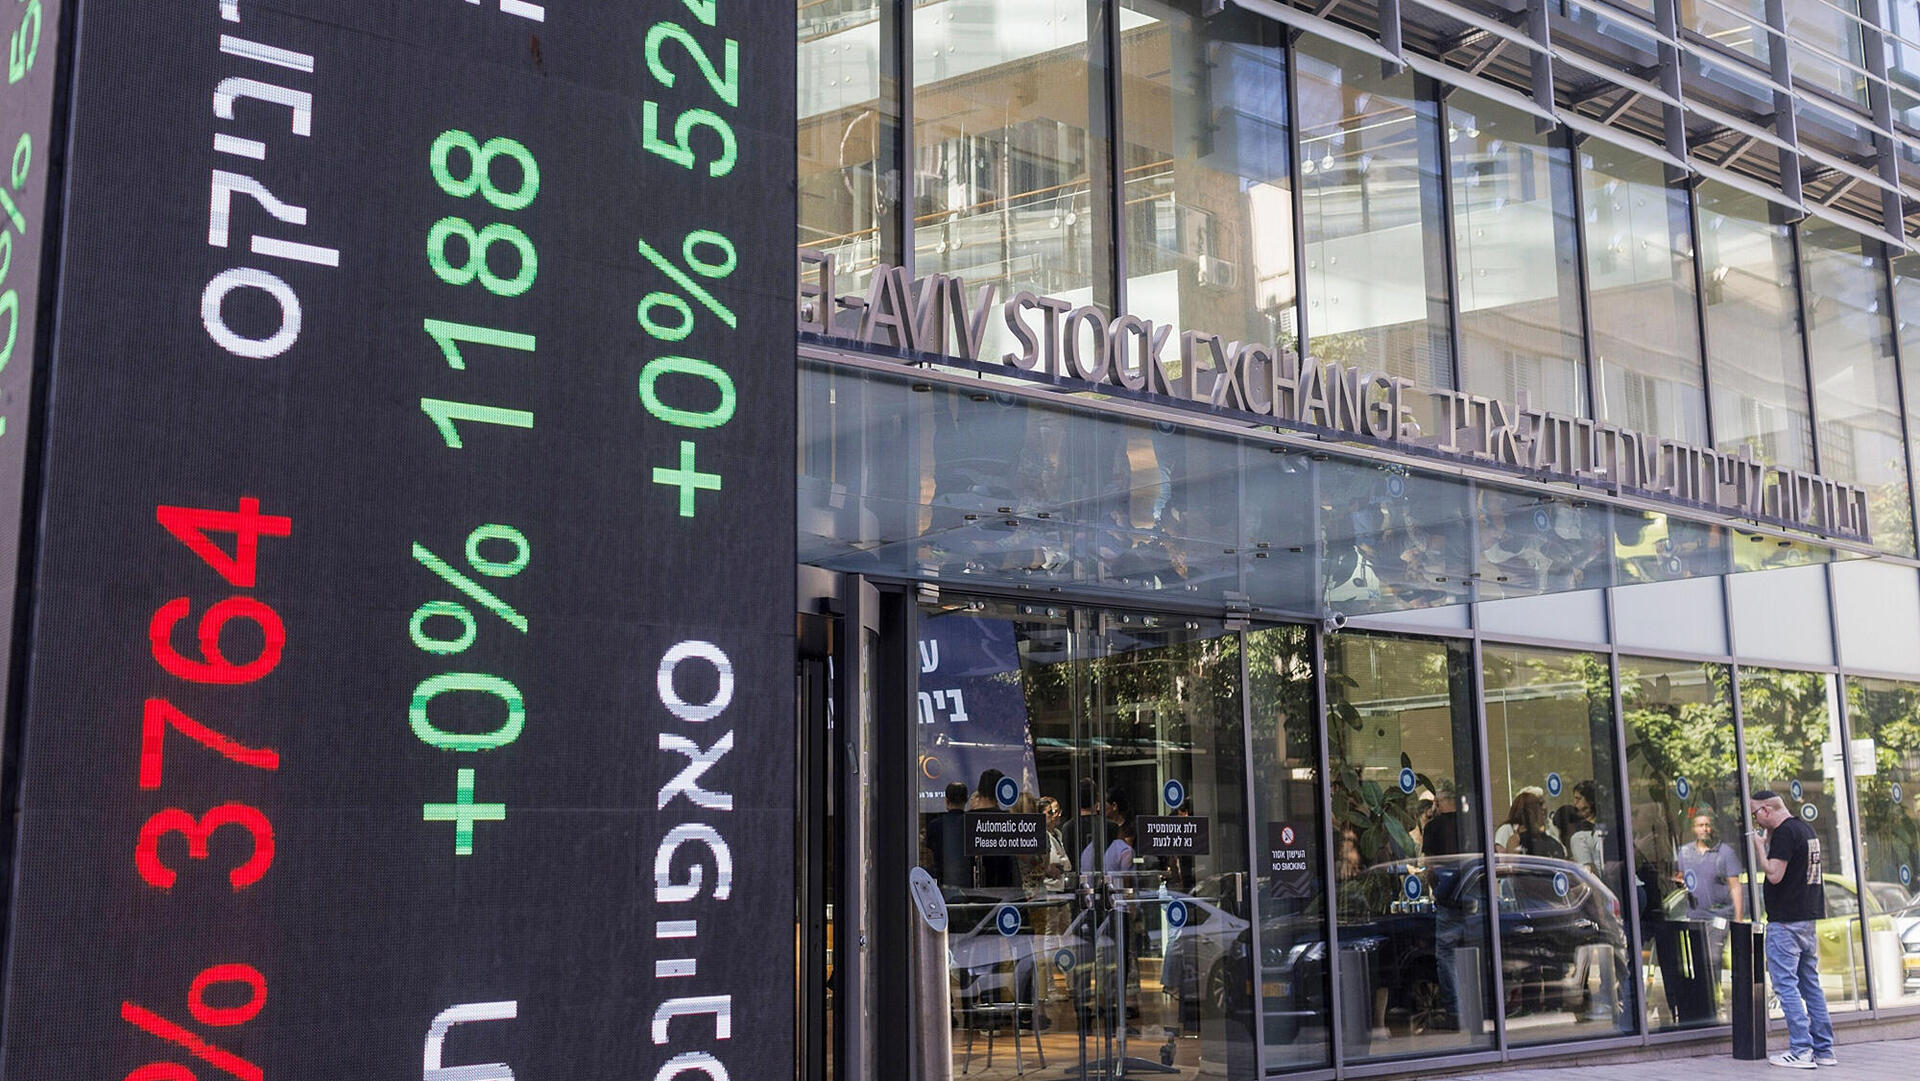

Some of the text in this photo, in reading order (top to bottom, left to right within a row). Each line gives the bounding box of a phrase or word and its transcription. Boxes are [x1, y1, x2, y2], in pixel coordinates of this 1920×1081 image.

[9, 0, 41, 84] 5
[201, 0, 340, 359] וניקס
[422, 129, 540, 449] 1188
[638, 229, 738, 518] +0%
[1003, 291, 1175, 397] STOCK
[1182, 329, 1416, 445] EXCHANGE
[135, 497, 291, 889] 3764
[409, 523, 531, 855] +0%
[974, 836, 1038, 848] Please do not touch
[976, 819, 1037, 833] Automatic door
[1152, 835, 1193, 847] נא לא לגעת
[1183, 822, 1197, 833] דלת
[1272, 862, 1307, 871] NO SMOKING
